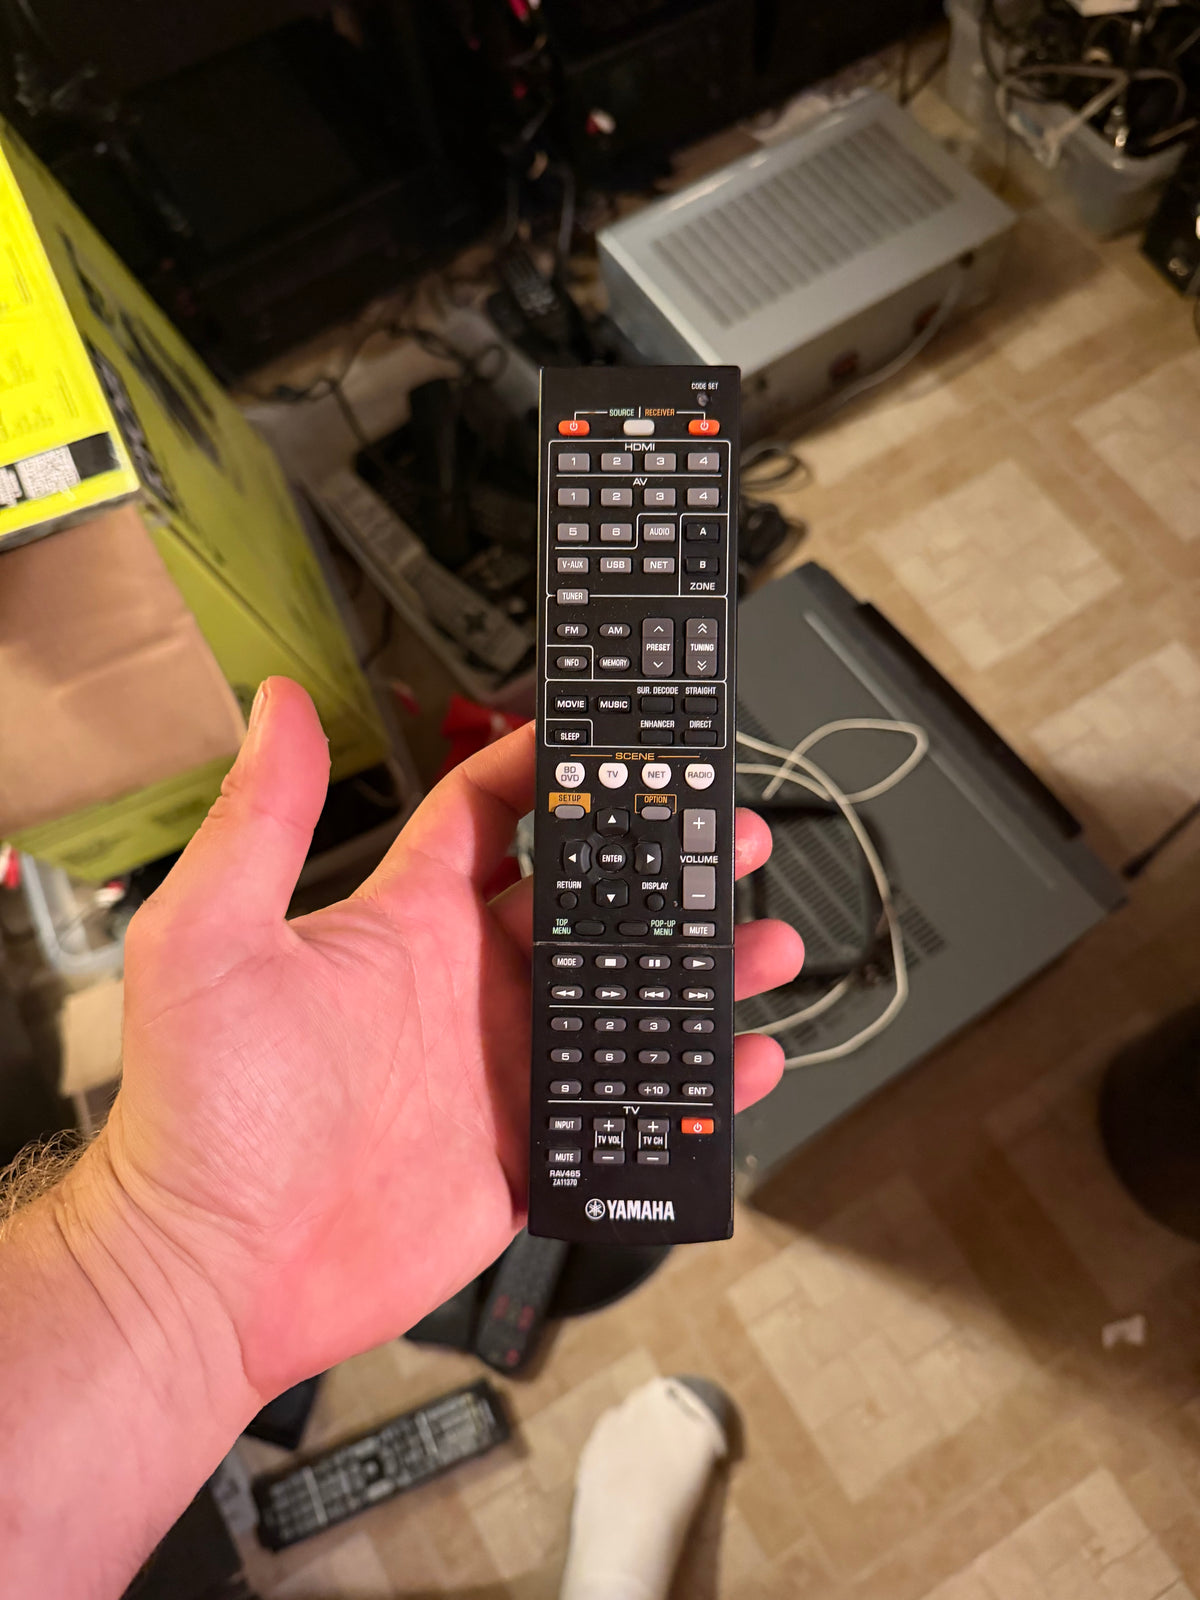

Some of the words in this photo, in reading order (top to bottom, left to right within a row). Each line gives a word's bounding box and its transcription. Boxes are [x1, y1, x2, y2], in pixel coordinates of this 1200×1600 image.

[691, 382, 707, 390] CODE
[708, 382, 719, 390] SET
[609, 408, 635, 417] SOURCE
[644, 408, 675, 417] RECEIVER
[624, 443, 656, 452] HDMI
[571, 457, 576, 466] 1
[613, 457, 621, 466] 2
[656, 457, 665, 466] 3
[699, 457, 708, 466] 4
[632, 478, 648, 486] AV
[570, 492, 576, 501] 1
[612, 492, 621, 501] 2
[656, 492, 665, 501] 3
[699, 492, 708, 501] 4
[569, 528, 577, 536] 5
[612, 528, 621, 536] 6
[649, 527, 670, 536] AUDIO
[700, 528, 707, 536] A
[562, 560, 584, 569] V-AUX
[606, 561, 625, 569] USB
[650, 561, 669, 569] NET
[700, 561, 706, 569] B
[690, 582, 716, 591] ZONE
[562, 592, 583, 600] TUNER
[564, 659, 579, 667] INFO
[602, 659, 627, 667] MEMORY
[637, 687, 652, 695] SUR.
[653, 687, 679, 695] DECODE
[685, 687, 717, 695] STRAIGHT
[557, 700, 585, 708] MOVIE
[600, 701, 628, 709] MUSIC
[640, 720, 675, 728] ENHANCER
[689, 720, 712, 728] DIRECT
[615, 752, 655, 761] SCENE
[564, 766, 576, 774] BD
[561, 774, 579, 782] DVD
[687, 771, 713, 779] RADIO
[558, 794, 581, 802] SETUP
[644, 796, 668, 804] OPTION
[680, 855, 719, 863] VOLUME
[556, 881, 582, 889] RETURN
[642, 882, 669, 890] DISPLAY
[556, 919, 569, 927] TOP
[651, 920, 676, 928] POP-UP
[552, 927, 571, 935] MENU
[653, 928, 673, 936] MENU
[557, 958, 577, 966] MODE
[563, 1021, 568, 1029] 1
[650, 1054, 658, 1062] 7
[694, 1055, 702, 1063] 8
[561, 1085, 570, 1093] 9
[644, 1086, 663, 1094] +10
[688, 1087, 707, 1095] ENT
[623, 1106, 640, 1114] TV
[555, 1121, 575, 1129] INPUT
[598, 1136, 607, 1144] TV
[608, 1136, 621, 1144] VOL
[643, 1136, 652, 1144] TV
[653, 1137, 663, 1145] CH
[555, 1153, 574, 1161] MUTE
[549, 1170, 581, 1178] RAV465
[607, 1201, 675, 1220] YAMAHA
